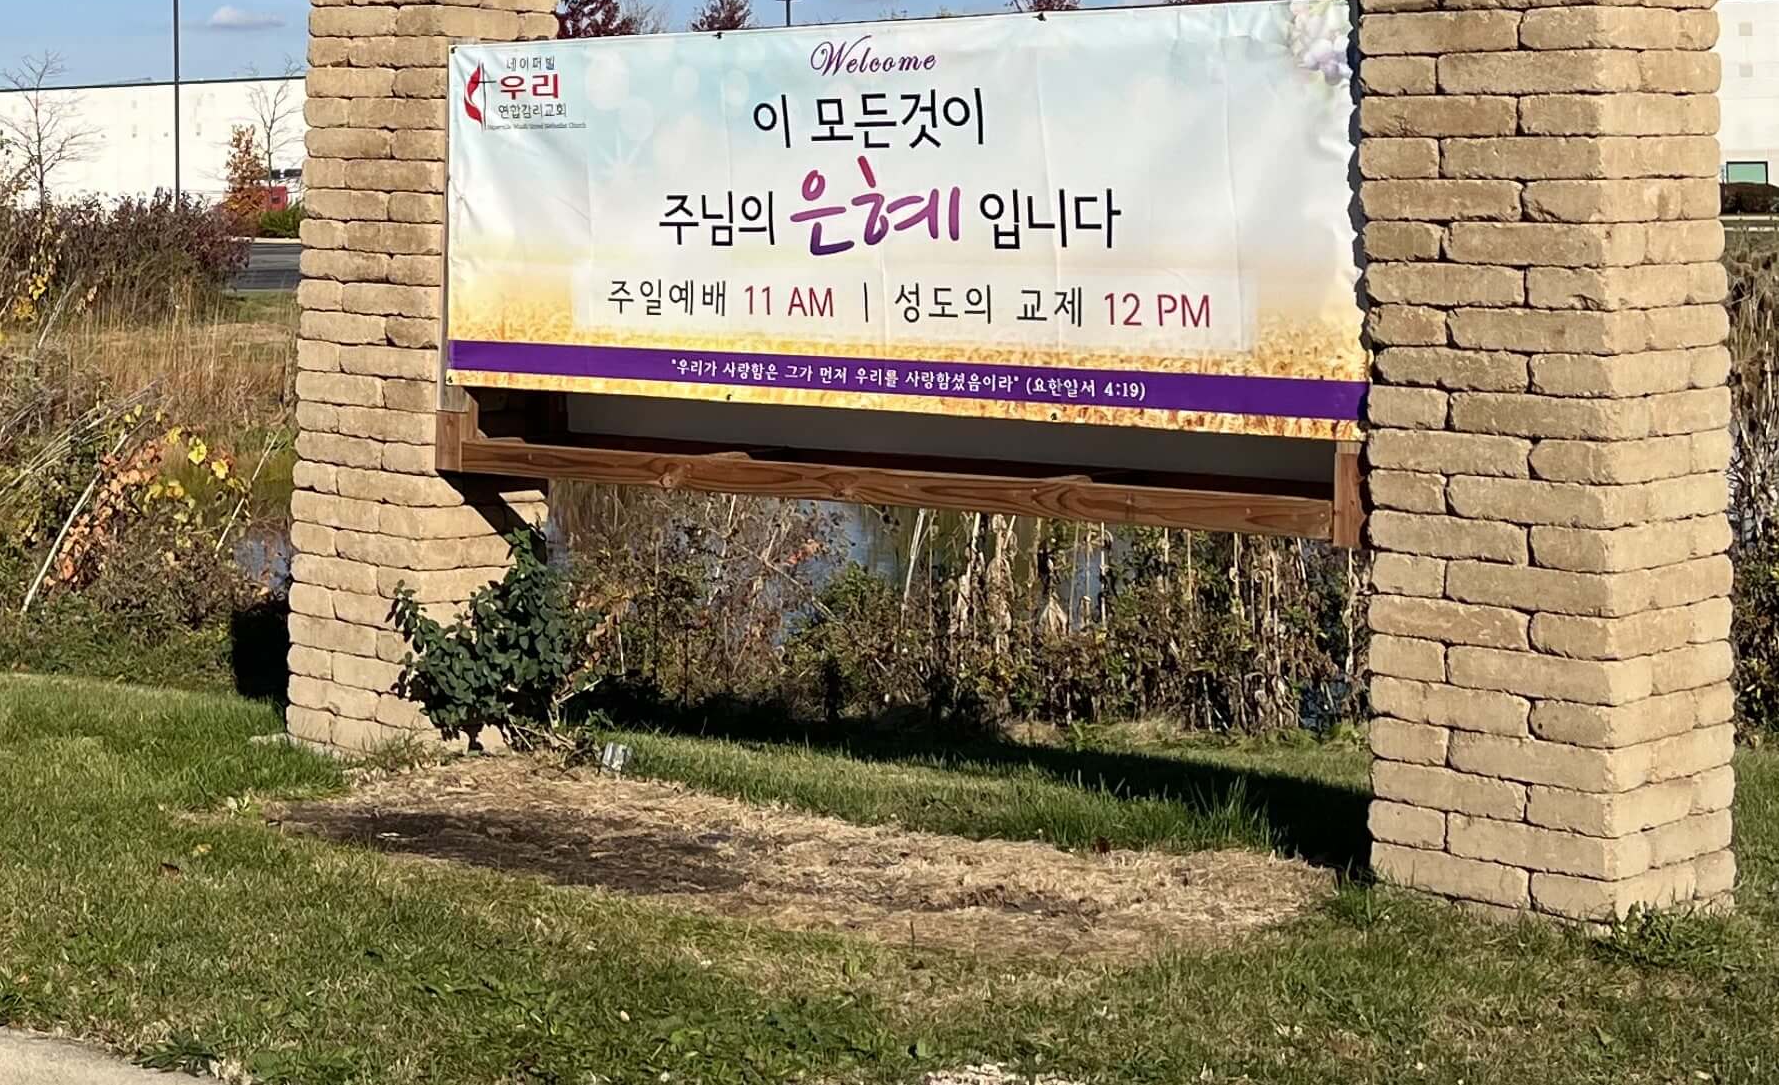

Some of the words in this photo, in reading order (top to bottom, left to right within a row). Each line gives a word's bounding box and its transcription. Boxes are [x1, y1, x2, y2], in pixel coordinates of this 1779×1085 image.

[810, 35, 936, 76] Welcome
[500, 73, 559, 100] 우리
[753, 94, 791, 148] 이
[811, 87, 984, 148] 모든것이
[659, 191, 776, 247] 주님의
[790, 155, 960, 256] 은혜
[979, 188, 1122, 250] 입니다
[608, 279, 726, 316] 주일예배
[744, 285, 771, 315] 11
[787, 287, 834, 317] AM
[894, 283, 992, 324] 성도의
[1016, 286, 1082, 327] 교제
[1104, 292, 1142, 326] 12
[1157, 294, 1210, 328] PM
[722, 361, 778, 381] 사랑함은
[784, 365, 813, 382] 그가
[820, 366, 847, 384] 먼저
[855, 367, 899, 388] 우리를
[1026, 377, 1095, 398] (요한일서
[1104, 382, 1146, 401] 4:19)
